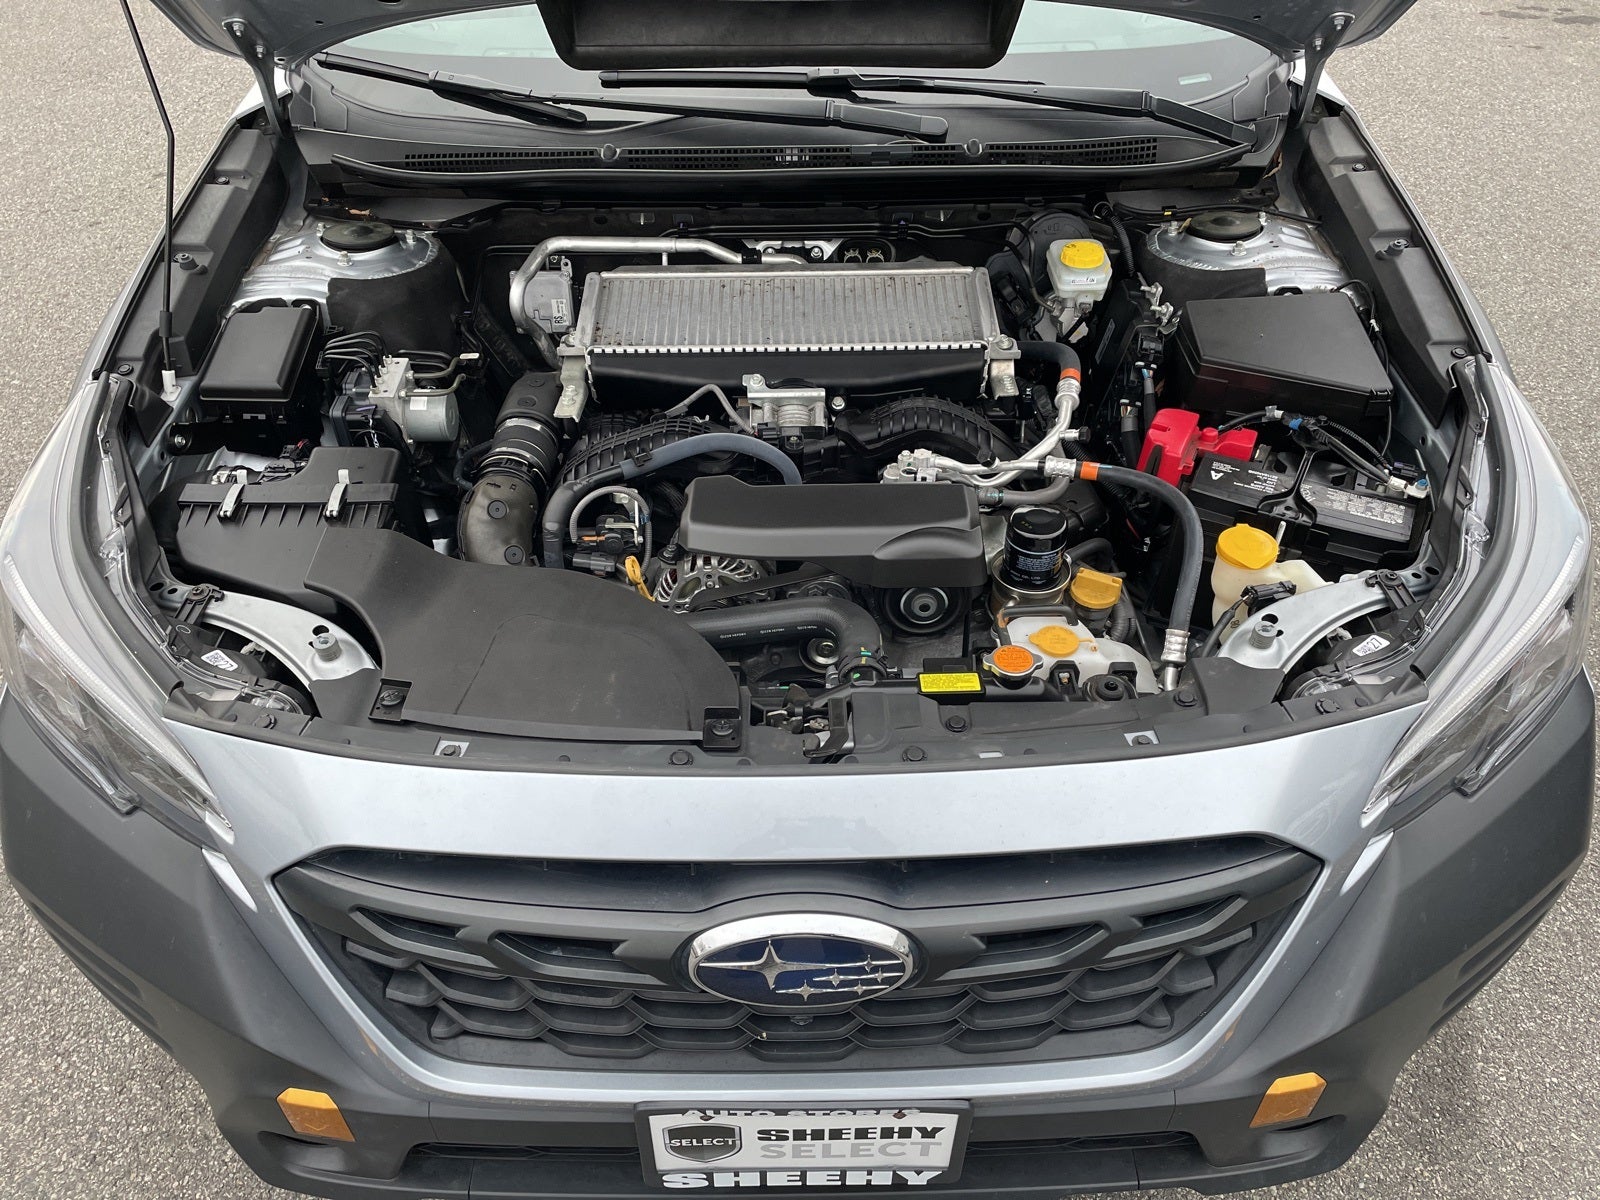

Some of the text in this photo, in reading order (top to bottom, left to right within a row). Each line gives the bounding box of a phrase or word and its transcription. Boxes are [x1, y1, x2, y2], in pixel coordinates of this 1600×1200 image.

[756, 1127, 946, 1141] SHEEHY
[669, 1137, 737, 1147] SELECT
[760, 1142, 942, 1158] SELECT
[662, 1170, 943, 1189] SHEEHY
